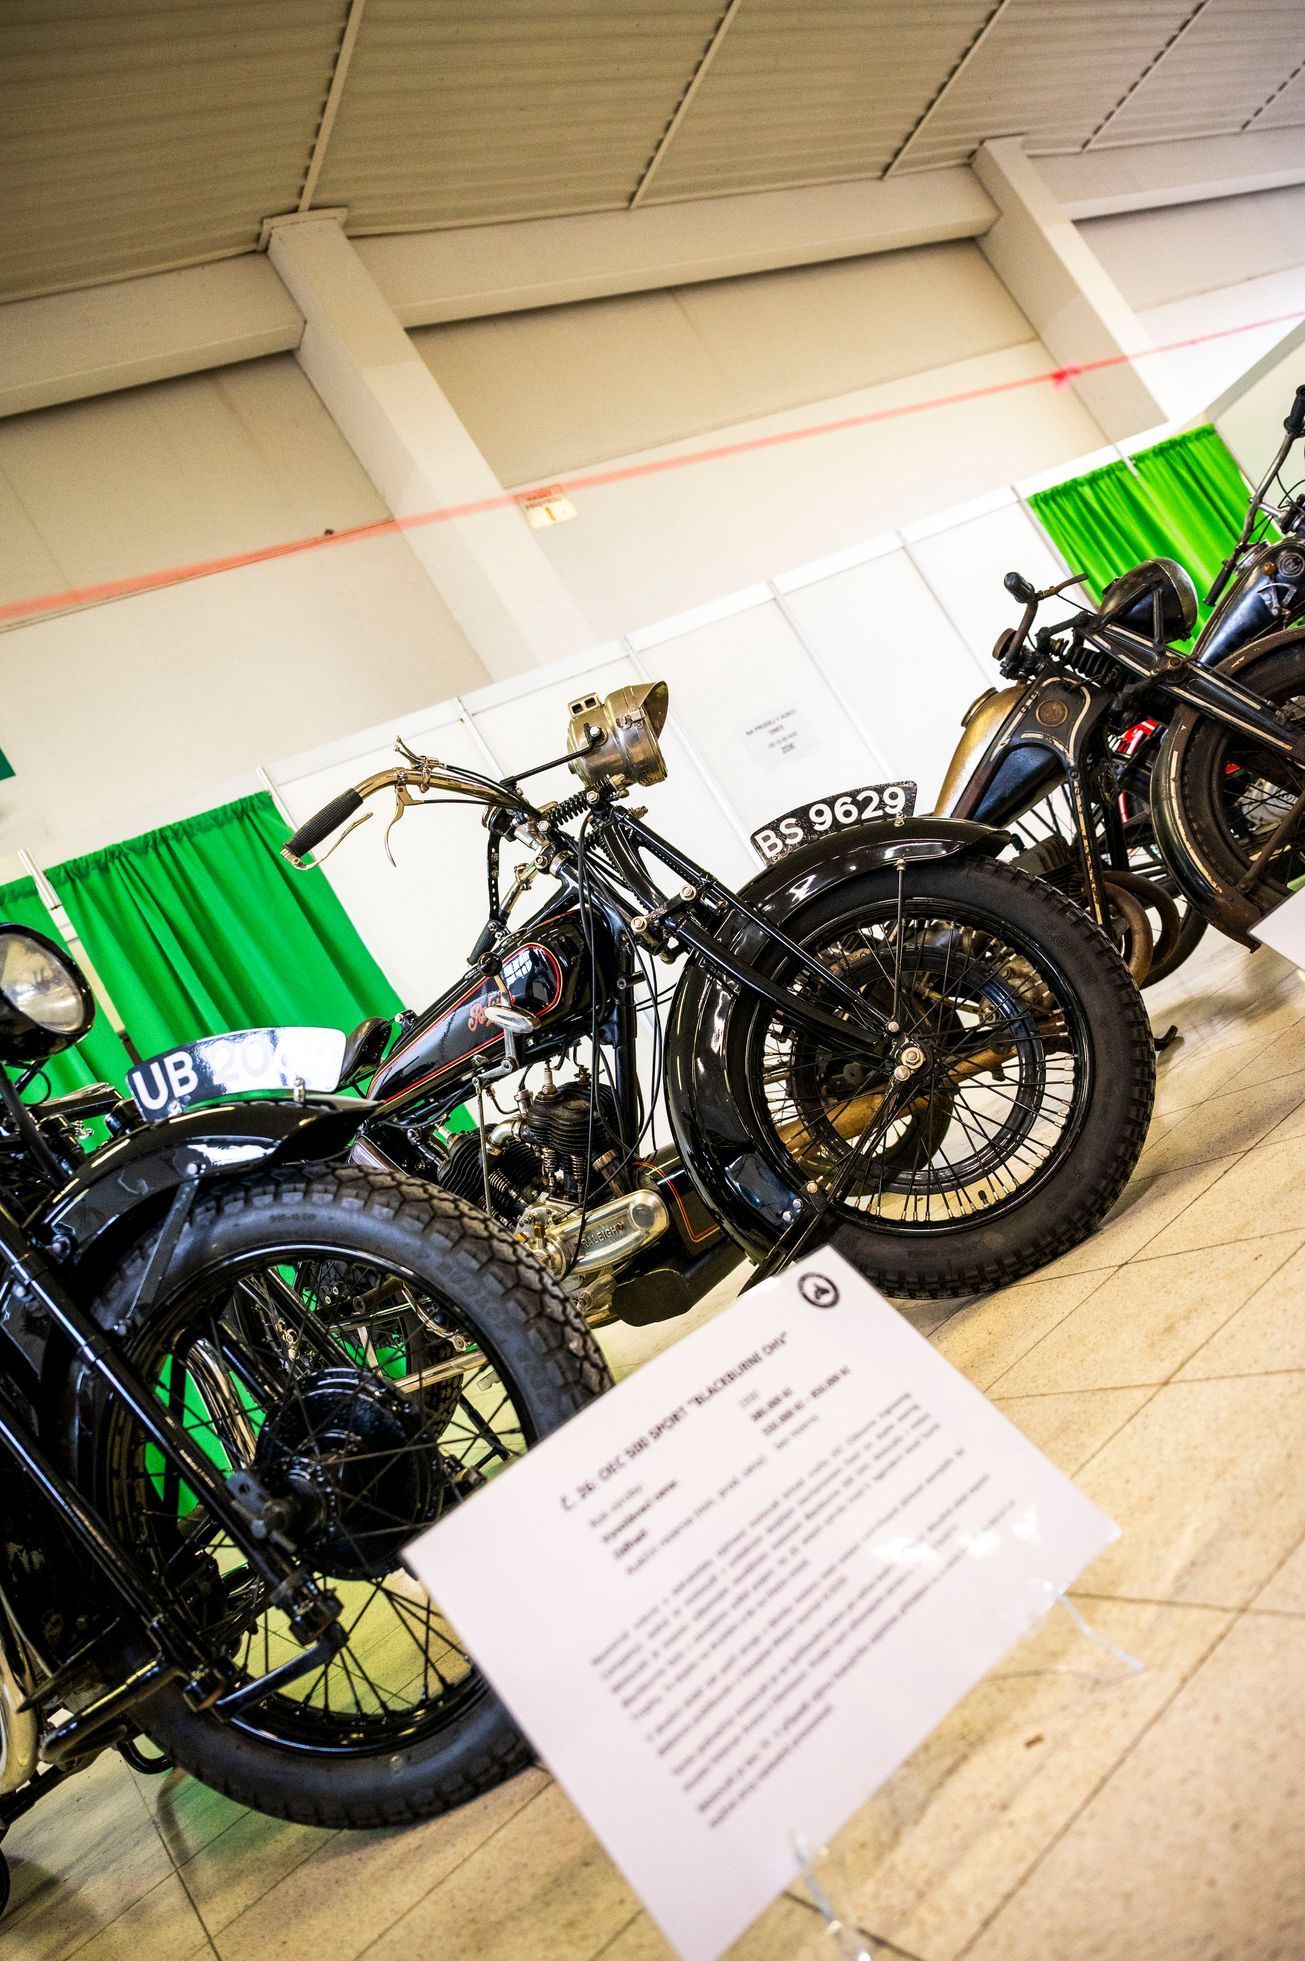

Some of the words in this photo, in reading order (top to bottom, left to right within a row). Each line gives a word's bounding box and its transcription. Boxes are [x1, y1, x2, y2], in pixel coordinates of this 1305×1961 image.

[754, 818, 803, 859] BS
[809, 786, 906, 832] 9629
[132, 1051, 198, 1110] UB
[581, 1224, 619, 1249] RALEIGH
[648, 1406, 688, 1440] SPORT
